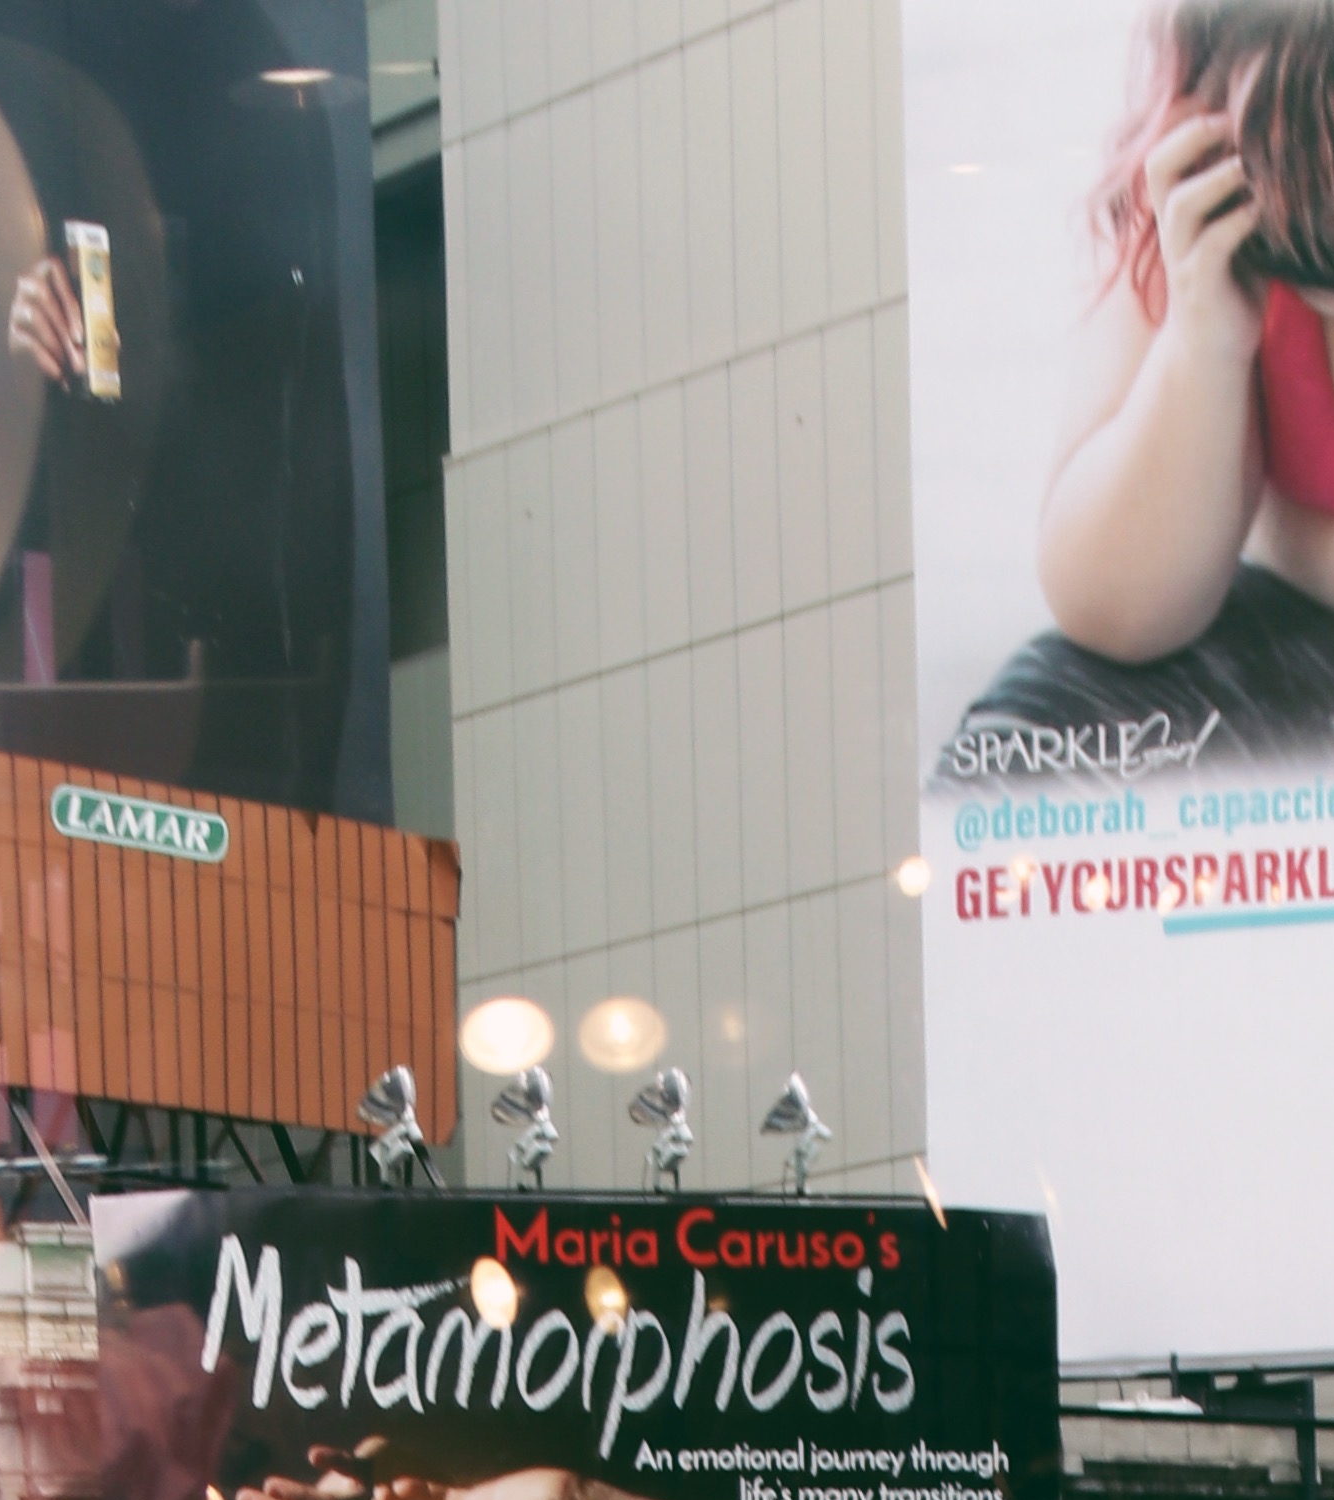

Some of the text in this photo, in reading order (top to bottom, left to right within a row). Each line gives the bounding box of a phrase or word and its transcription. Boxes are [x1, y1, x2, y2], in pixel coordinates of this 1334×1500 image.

[65, 793, 213, 854] LAMAR
[493, 1206, 900, 1270] Maria Caruso's
[201, 1233, 916, 1461] Metamorphosis
[634, 1438, 1010, 1487] An emotional journey through
